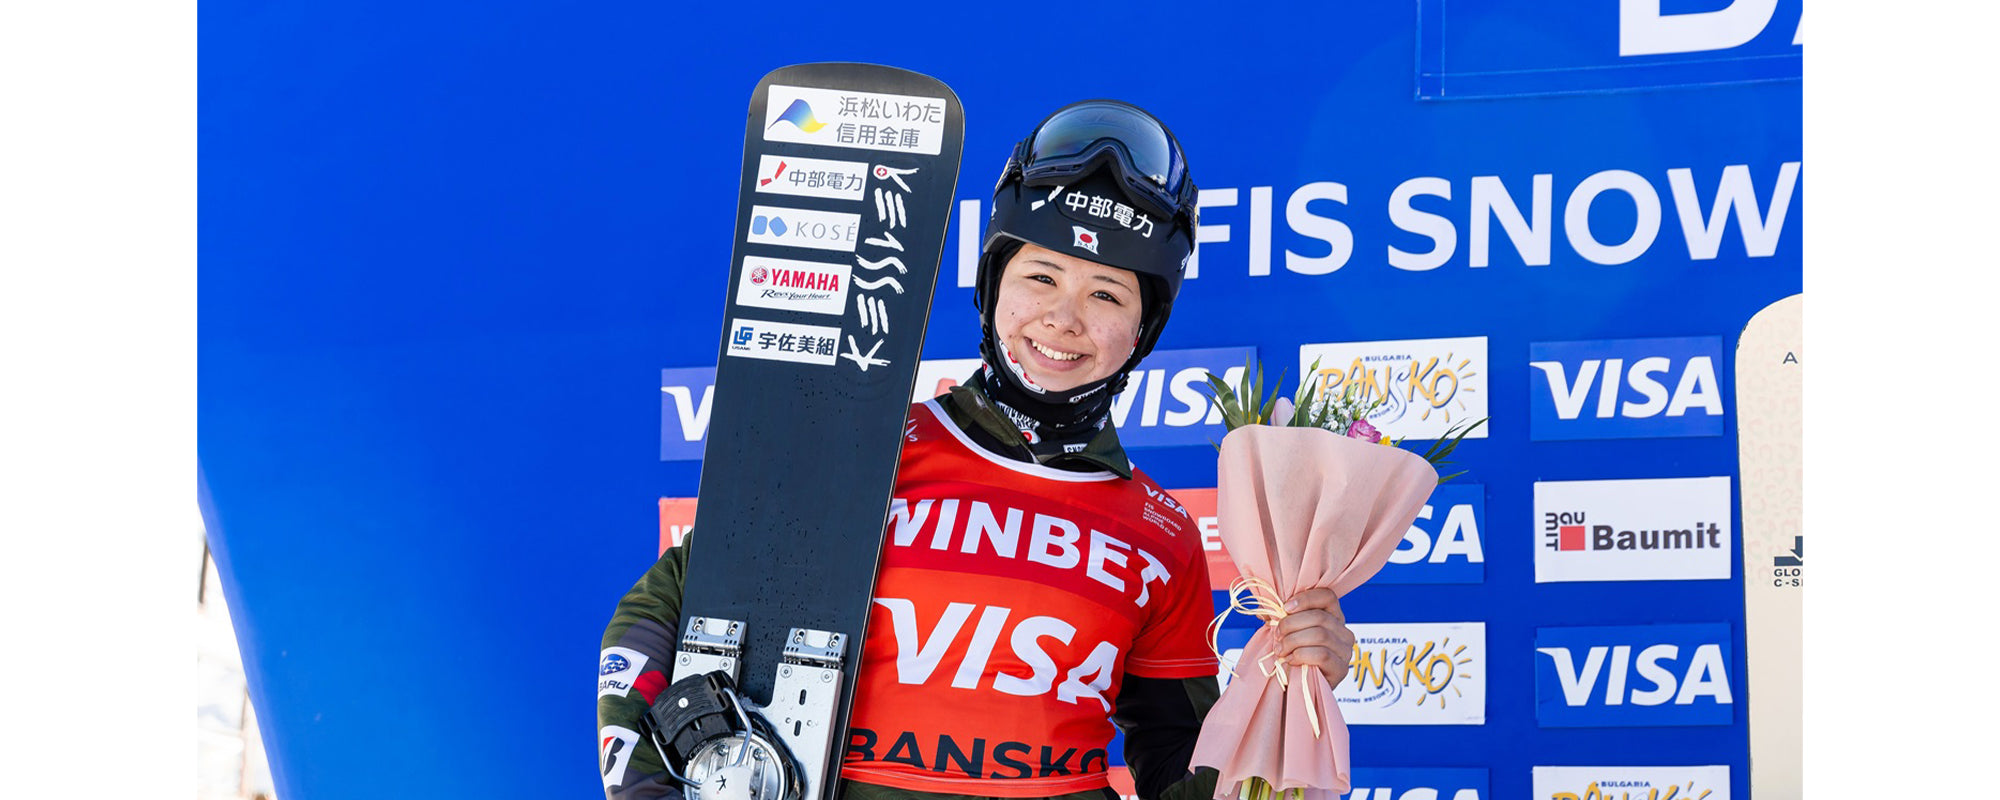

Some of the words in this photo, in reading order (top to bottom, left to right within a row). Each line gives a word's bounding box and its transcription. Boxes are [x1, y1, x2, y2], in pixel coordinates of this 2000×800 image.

[838, 96, 942, 124] 浜松いわた
[836, 122, 921, 149] 信用金庫
[789, 169, 864, 192] 中部電力
[1065, 190, 1154, 239] 中部電力
[1184, 182, 1354, 279] FIS
[1387, 162, 1802, 271] SNOW
[795, 221, 857, 243] KOSÉ
[772, 268, 839, 292] YAMAHA
[758, 331, 836, 357] 宇佐美組
[1365, 354, 1412, 363] BULGARIA
[1529, 356, 1724, 420] VISA
[1141, 482, 1188, 519] VISA
[1386, 503, 1484, 564] SA
[1593, 522, 1721, 551] Baumit
[886, 497, 1172, 608] WINBET
[1774, 568, 1803, 577] GLO
[873, 597, 1119, 713] VISA
[1360, 637, 1409, 645] BULGARIA
[1536, 643, 1734, 706] VISA
[1601, 780, 1651, 788] BULGARIA
